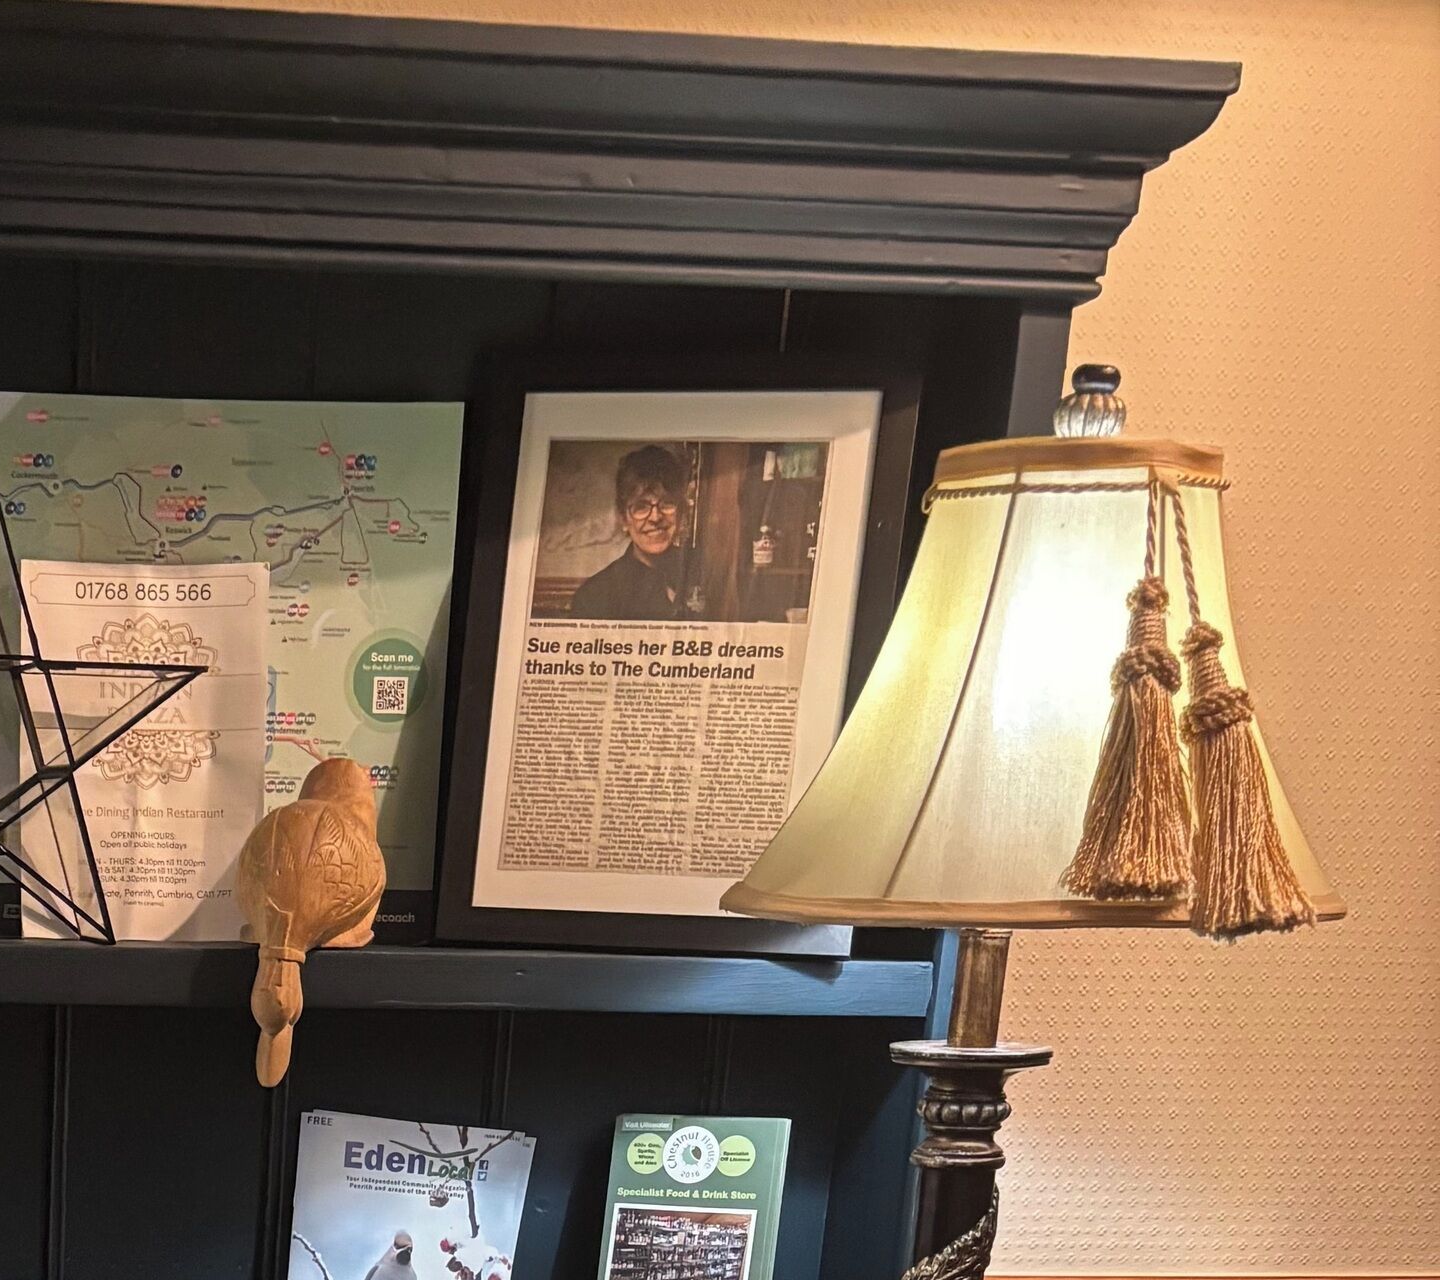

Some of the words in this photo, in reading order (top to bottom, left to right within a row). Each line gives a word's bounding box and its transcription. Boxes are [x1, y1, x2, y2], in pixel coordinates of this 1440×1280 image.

[75, 581, 128, 600] 01768
[135, 583, 169, 601] 865
[176, 583, 211, 601] 566
[527, 638, 561, 654] Sue
[565, 638, 634, 656] realises
[637, 639, 667, 656] her
[671, 640, 713, 657] B&B
[717, 642, 785, 659] dreams
[370, 652, 396, 663] Scan
[525, 659, 585, 675] thanks
[589, 662, 607, 676] to
[612, 660, 643, 677] The
[648, 661, 755, 680] Cumberland
[96, 807, 130, 820] Dining
[132, 807, 164, 819] Indian
[110, 832, 147, 840] OPENING
[100, 841, 122, 849] Open
[134, 840, 156, 849] public
[157, 842, 187, 851] holidays
[124, 889, 155, 899] Penrith,
[156, 890, 194, 899] Cumbria,
[306, 1116, 334, 1127] FREE
[344, 1141, 426, 1175] Eden
[427, 1158, 476, 1180] Local
[617, 1187, 664, 1197] Specialist
[666, 1188, 690, 1198] Food
[692, 1190, 700, 1198] &
[702, 1190, 729, 1199] Drink
[730, 1190, 757, 1200] Store
